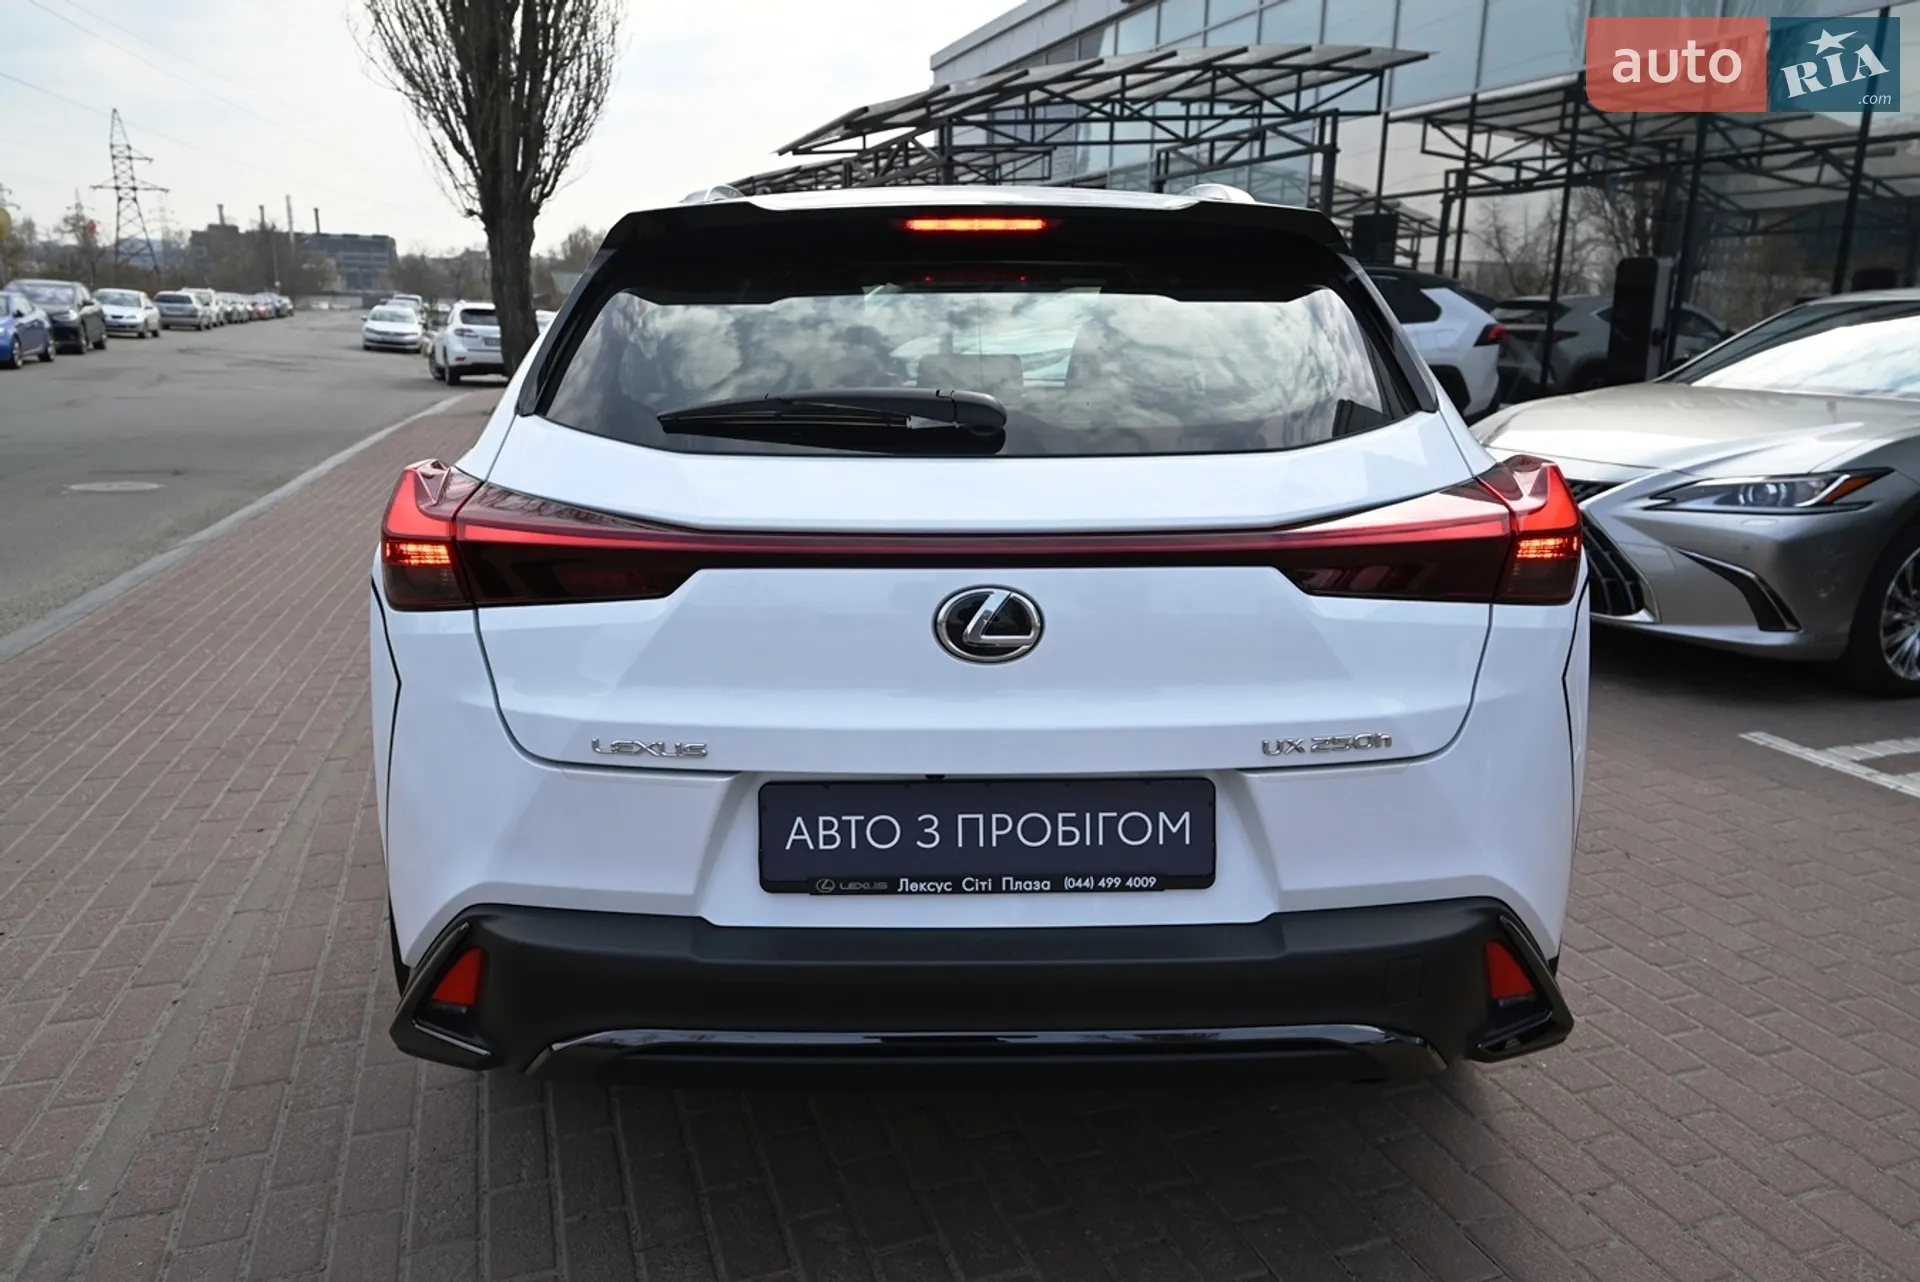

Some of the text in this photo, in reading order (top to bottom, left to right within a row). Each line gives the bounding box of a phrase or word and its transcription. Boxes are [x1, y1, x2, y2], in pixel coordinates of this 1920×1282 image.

[591, 738, 708, 758] LEXUS
[1262, 732, 1393, 756] UX 250h
[785, 814, 902, 850] АВТО
[957, 811, 1192, 848] ПРОБІГОМ
[839, 881, 888, 890] LEXUS
[897, 876, 1157, 893] Лексус Сіті Плаза (044) 499 4009
